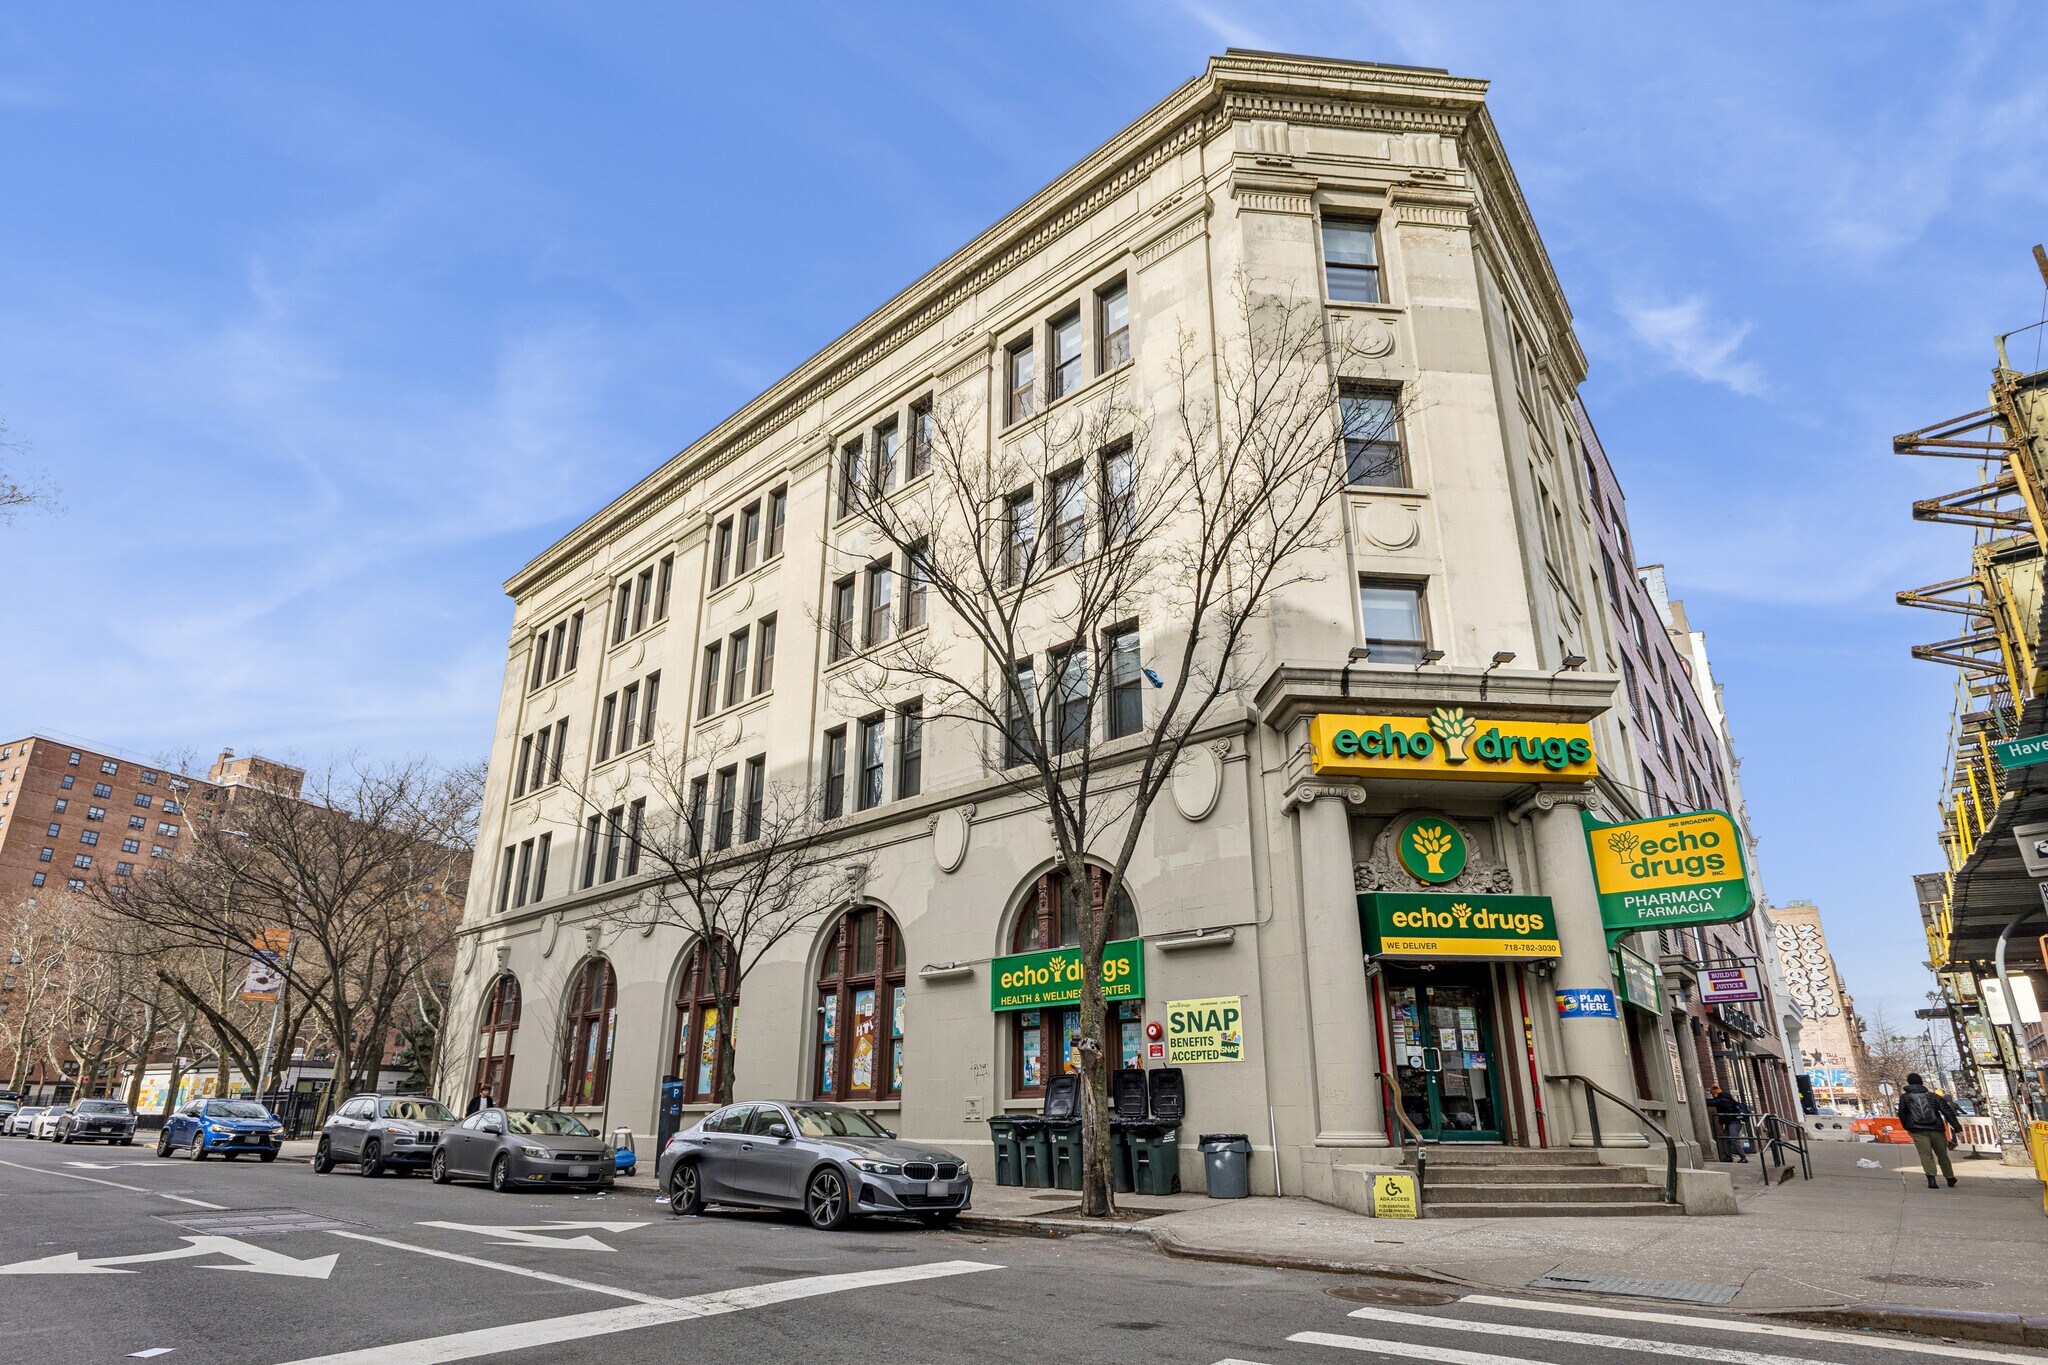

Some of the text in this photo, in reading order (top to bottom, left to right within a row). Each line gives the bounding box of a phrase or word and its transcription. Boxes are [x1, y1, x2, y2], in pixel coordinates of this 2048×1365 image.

[1333, 723, 1592, 770] echo drugs
[1680, 817, 1716, 826] BROADWAY
[1640, 830, 1720, 856] echo
[1630, 853, 1725, 879] drugs
[1624, 886, 1723, 908] PHARMACY
[1638, 902, 1714, 918] FARMACIA
[1392, 907, 1544, 935] echo drugs
[1402, 942, 1437, 950] DELIVER
[1504, 944, 1557, 952] 718-782-3030
[1001, 958, 1130, 988] echo drgs
[1711, 971, 1730, 979] BUILD
[1715, 982, 1739, 990] JUSTICE
[1001, 984, 1131, 1005] HEALTH & WELLNES ENTER
[1580, 994, 1606, 1002] PLAY
[1580, 1003, 1611, 1011] HERE.
[1170, 1008, 1239, 1034] SNAP
[1170, 1036, 1214, 1048] BENEFITS
[1171, 1050, 1219, 1061] ACCEPTED
